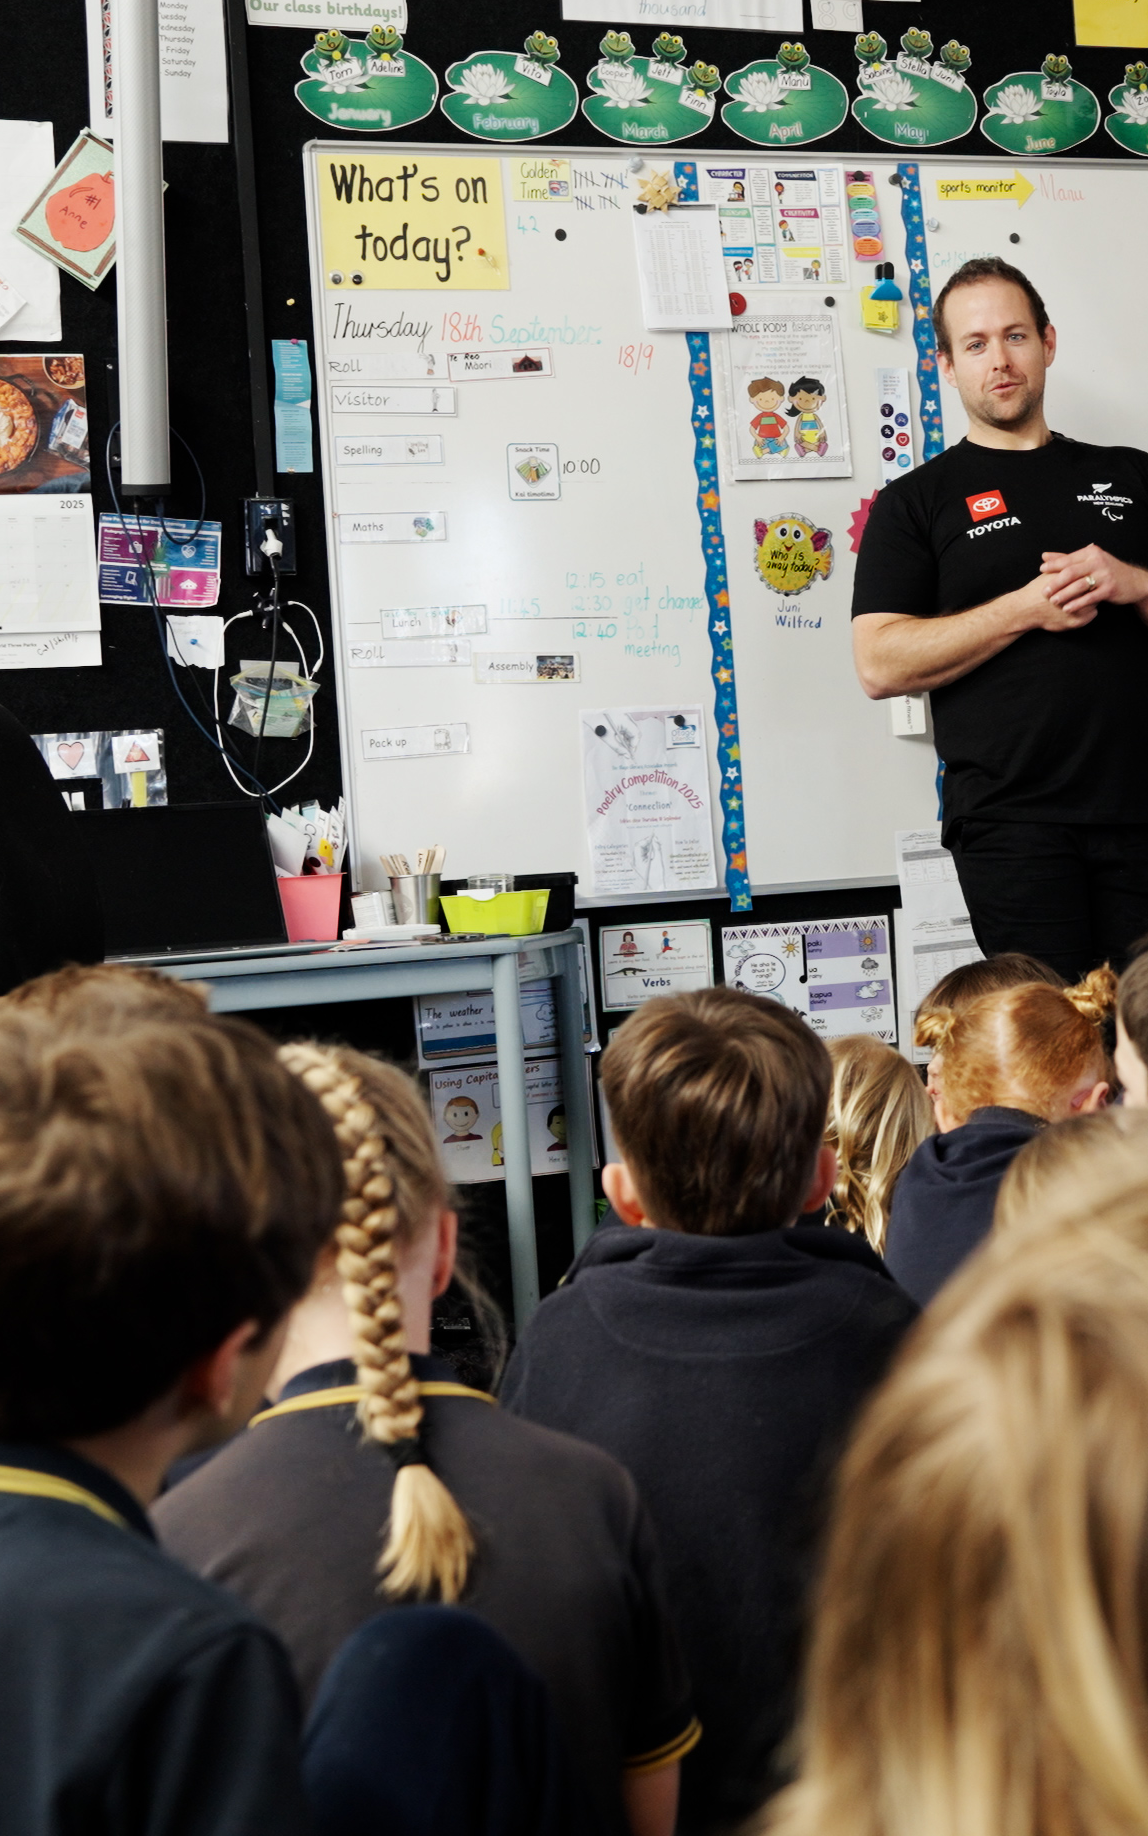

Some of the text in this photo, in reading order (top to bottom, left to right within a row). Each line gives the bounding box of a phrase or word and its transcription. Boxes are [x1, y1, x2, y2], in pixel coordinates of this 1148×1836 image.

[160, 2, 188, 11] Monday
[250, 0, 403, 22] Our class birthdays!
[638, 0, 707, 17] thousand
[166, 46, 190, 56] Friday
[162, 57, 196, 68] Saturday
[370, 61, 404, 75] Adeline
[900, 58, 928, 77] Stella
[164, 69, 192, 79] Sunday
[600, 66, 630, 80] Cooper
[864, 66, 893, 81] Sabine
[781, 75, 809, 88] Manu
[684, 93, 708, 110] Finn
[328, 103, 391, 126] January
[473, 114, 539, 134] February
[622, 123, 669, 140] March
[769, 122, 803, 142] April
[895, 123, 926, 142] May
[1025, 136, 1056, 153] June
[520, 162, 558, 180] Golden
[330, 163, 488, 204] What's on
[940, 182, 1016, 198] sports monitor
[1039, 174, 1086, 201] Manu
[59, 205, 88, 230] Anne
[516, 215, 541, 235] 42
[354, 222, 472, 283] today?
[332, 302, 433, 353] Thursday
[441, 311, 484, 343] 18th
[763, 322, 787, 333] BODY
[792, 322, 831, 334] listening
[463, 352, 480, 361] Reo
[617, 342, 654, 376] 18/9
[328, 360, 363, 373] Roll
[334, 391, 390, 407] Visitor
[344, 445, 383, 457] Spelling
[562, 458, 601, 475] 10:00
[60, 500, 85, 509] 2025
[1076, 495, 1133, 505] PARALYMPICS
[352, 522, 384, 532] Maths
[966, 516, 1022, 539] TOYOTA
[770, 550, 804, 561] Who is
[565, 561, 645, 590] 12:15 eat
[766, 558, 820, 578] away today?
[622, 587, 650, 615] get
[777, 599, 801, 613] Juni
[392, 617, 422, 628] Lunch
[775, 615, 822, 629] Wilfred
[572, 622, 618, 639] 12:40
[351, 645, 386, 659] Roll
[624, 641, 681, 667] meeting
[488, 660, 534, 673] Assembly
[369, 738, 407, 750] Pack up
[621, 769, 679, 790] Competition
[678, 784, 704, 809] 2025
[642, 977, 671, 988] Verbs
[810, 991, 832, 999] kapua
[425, 1005, 484, 1019] The weather
[435, 1072, 499, 1090] Using Capita
